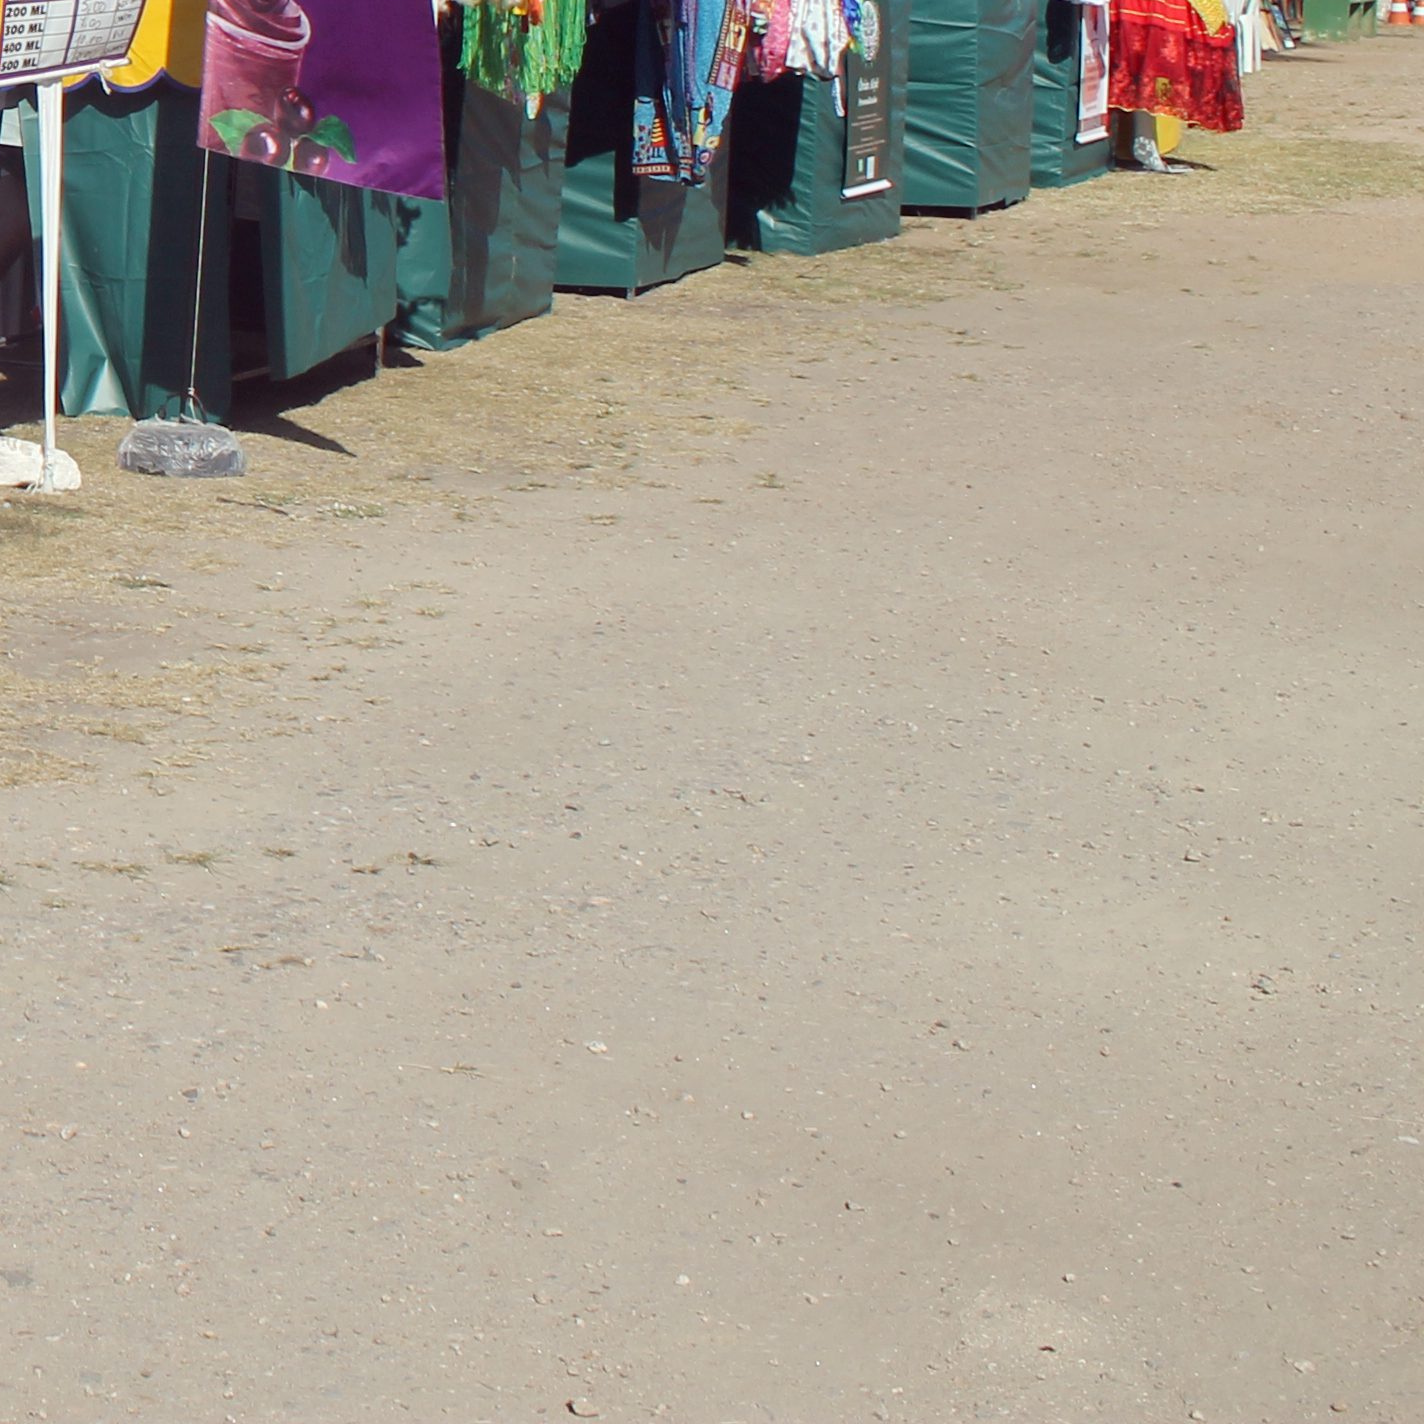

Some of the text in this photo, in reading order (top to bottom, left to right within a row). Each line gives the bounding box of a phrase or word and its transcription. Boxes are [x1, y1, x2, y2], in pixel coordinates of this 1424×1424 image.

[6, 5, 47, 18] 200 ML
[4, 22, 44, 36] 300 ML
[3, 39, 41, 53] 400 ML
[0, 56, 38, 72] 500 ML
